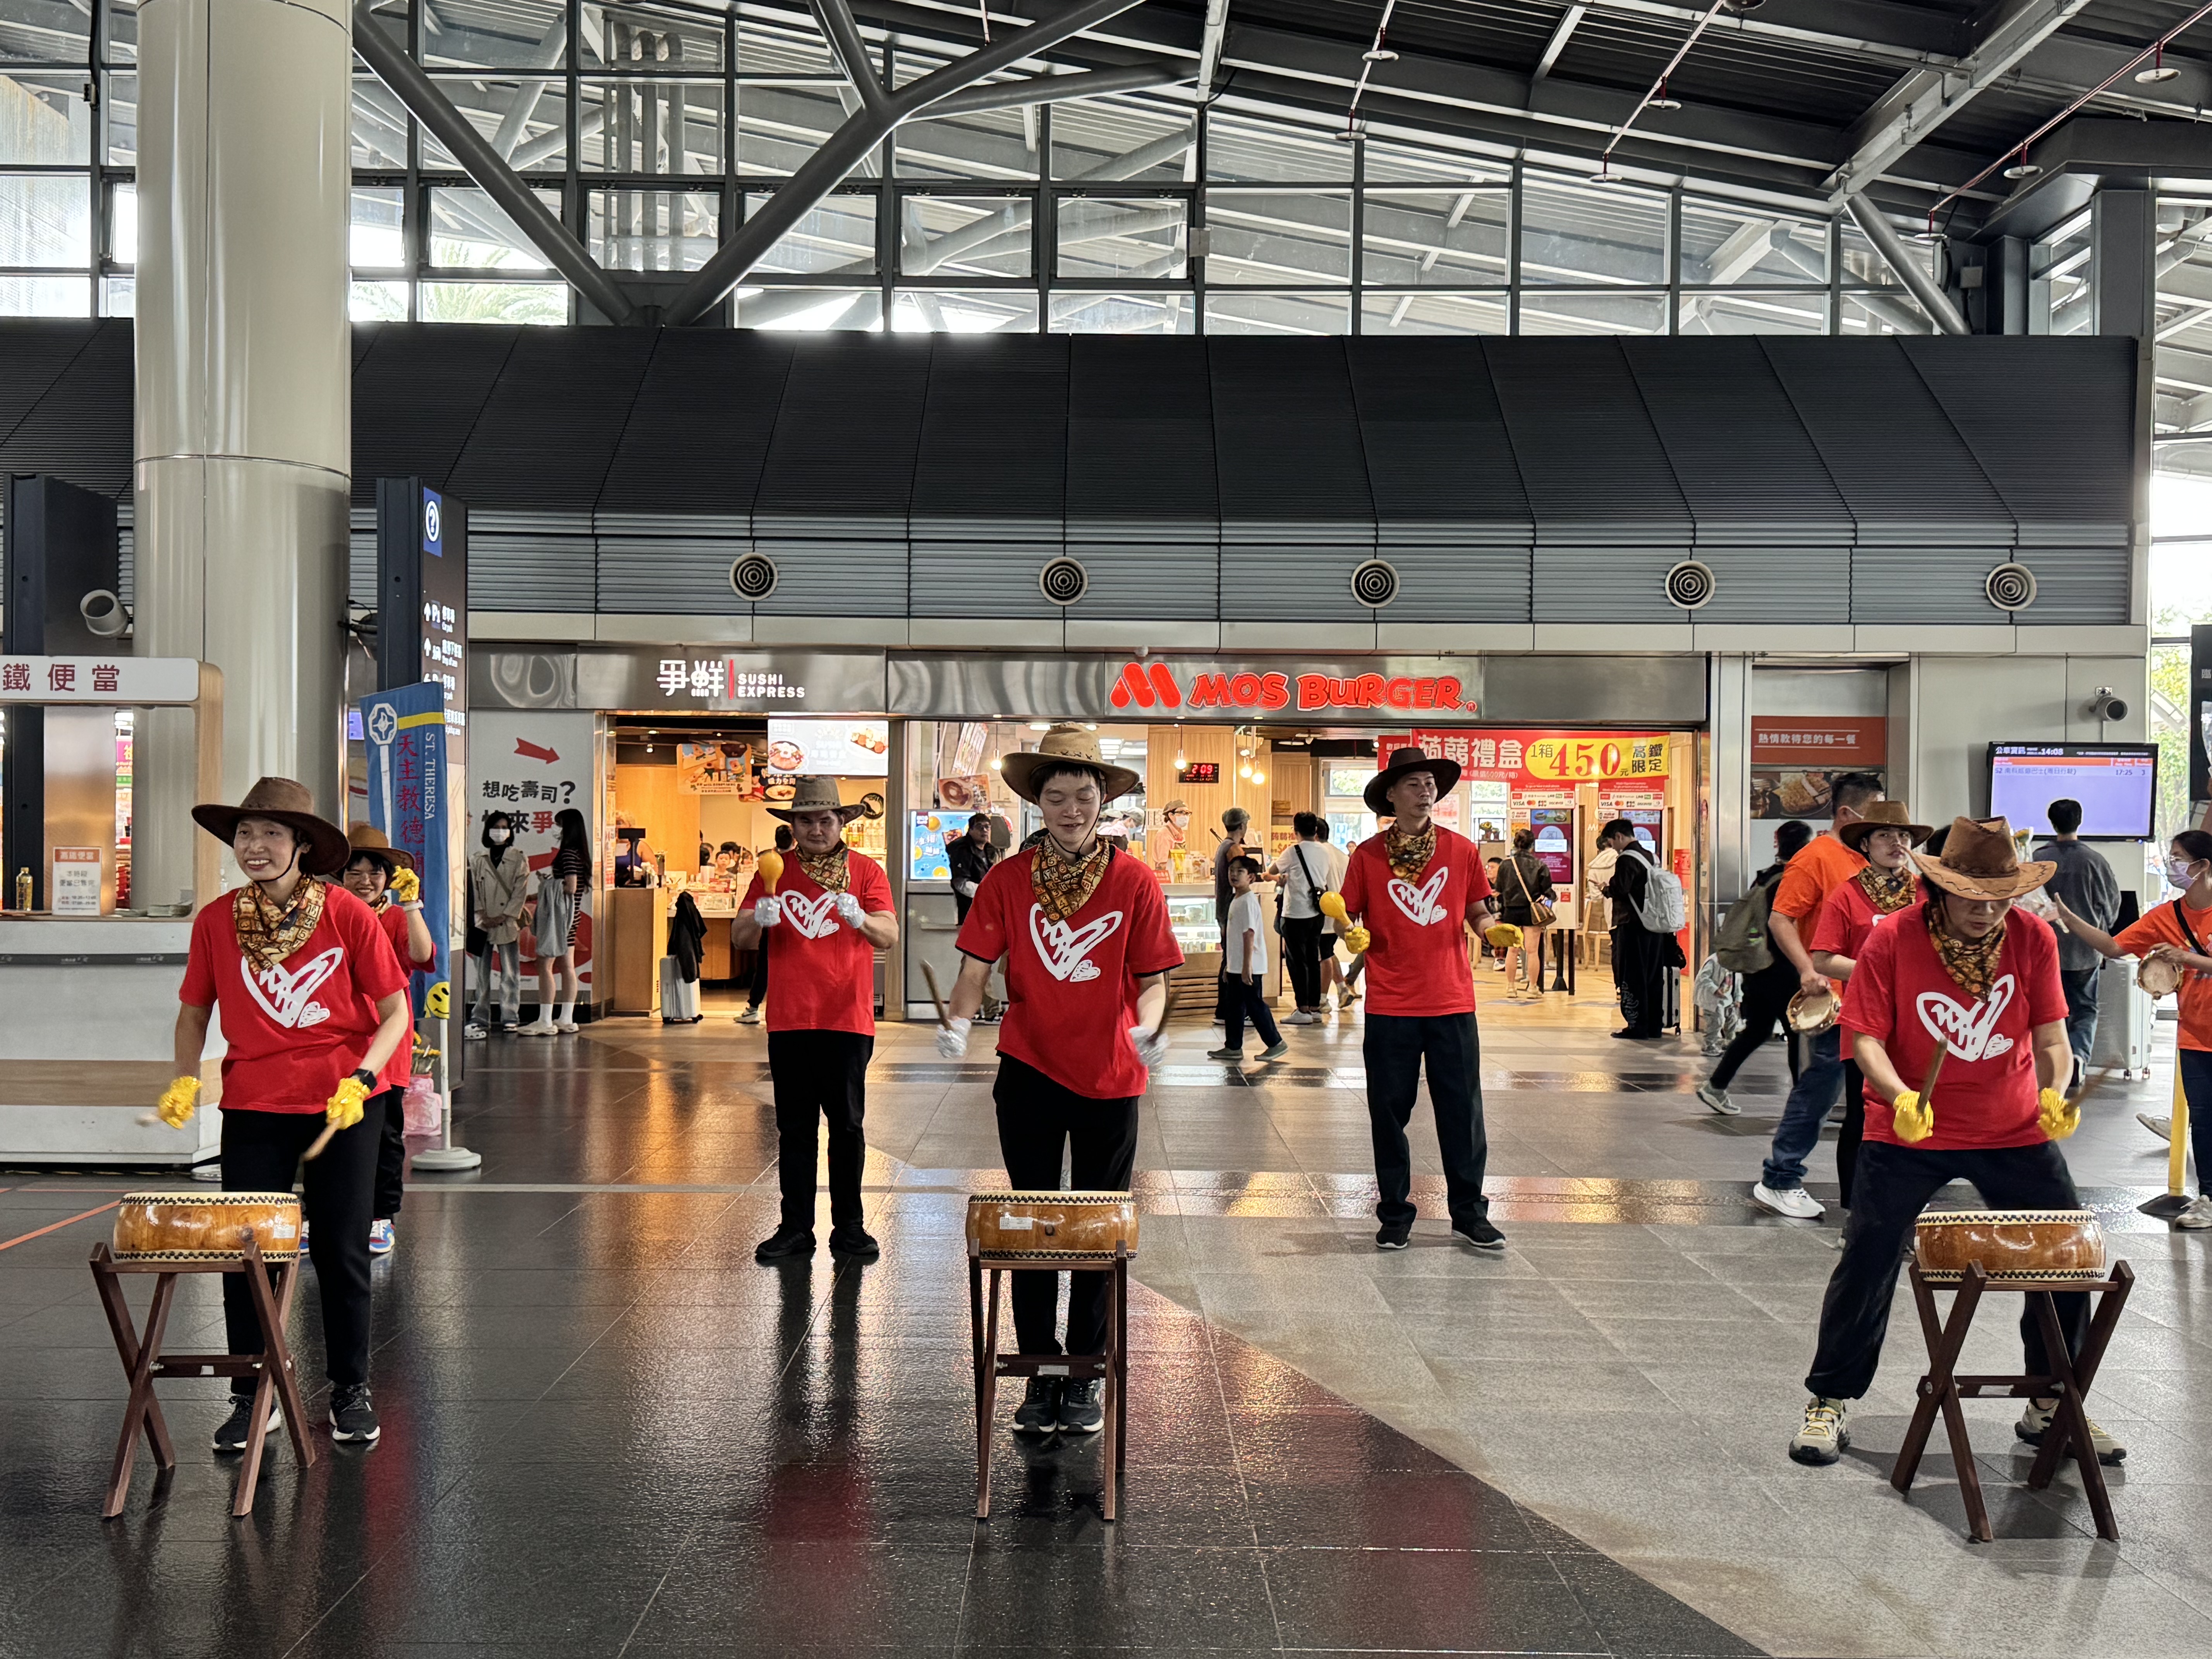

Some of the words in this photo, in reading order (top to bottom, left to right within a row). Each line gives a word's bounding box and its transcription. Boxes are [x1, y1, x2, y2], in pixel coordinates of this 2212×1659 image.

[2, 664, 120, 692] 鐵便當
[657, 659, 725, 697] 爭鮮
[737, 673, 783, 685] SUSHI
[737, 686, 805, 698] EXPRESS
[1187, 672, 1290, 711] MOS
[1296, 672, 1465, 711] BURGER
[425, 732, 435, 756] ST.
[1418, 734, 1523, 769] 蒟蒻禮盒
[1632, 743, 1663, 759] 高鐵
[1531, 744, 1553, 759] 1箱
[1549, 743, 1621, 777] 450
[1620, 768, 1629, 776] 元
[1632, 759, 1662, 774] 限定
[424, 759, 436, 820] THERESA
[483, 780, 576, 804] 想吃壽司?
[481, 810, 554, 834] 來爭
